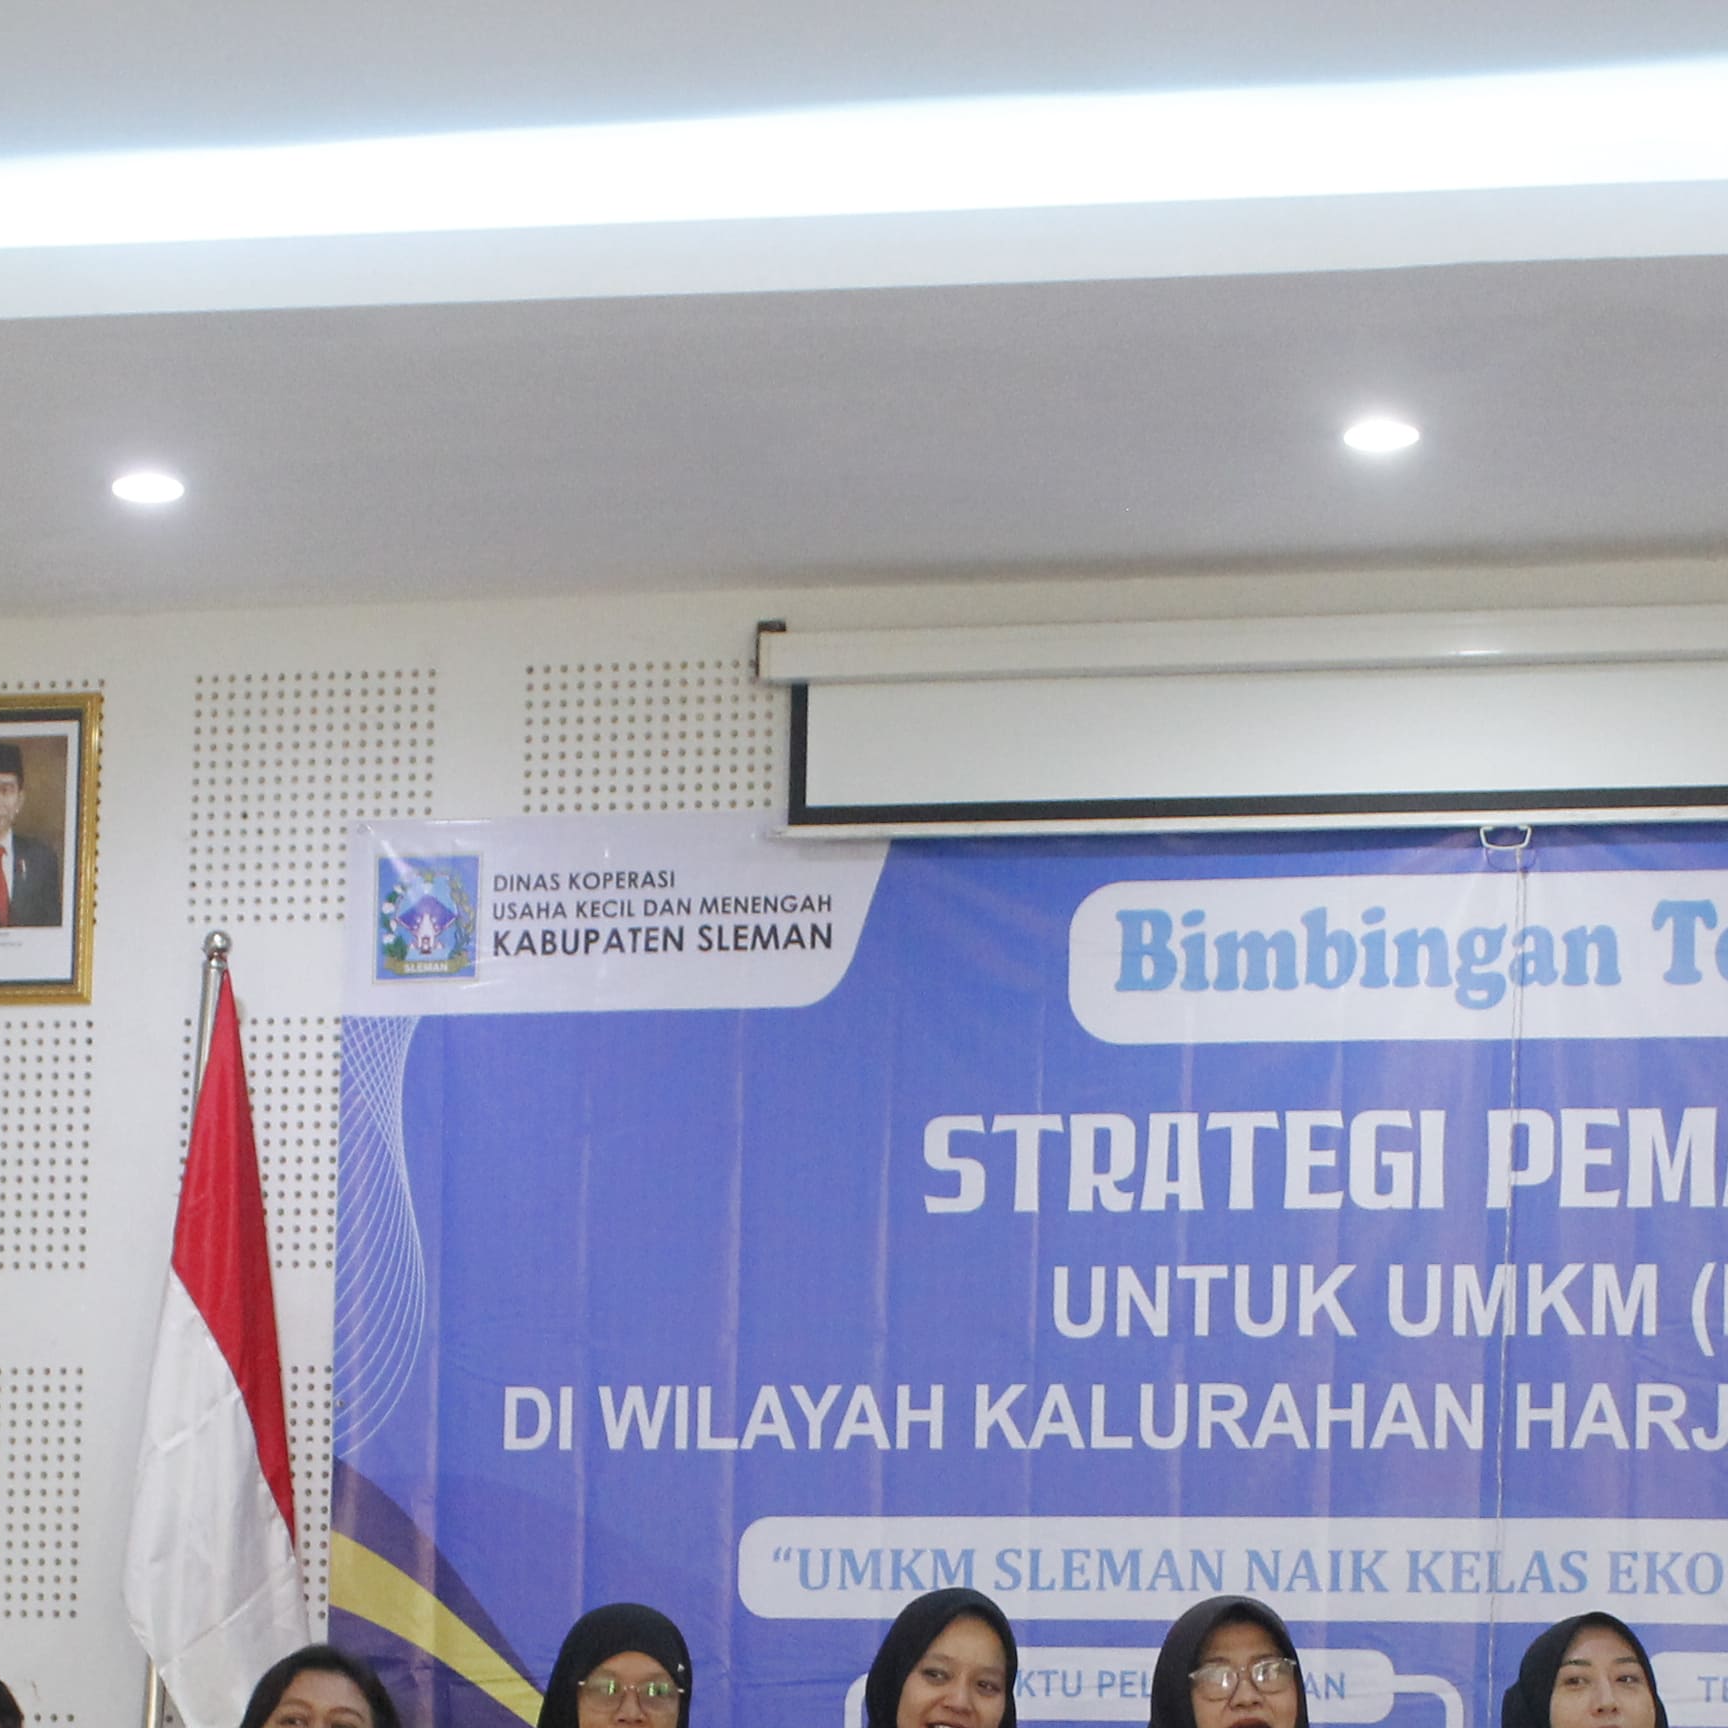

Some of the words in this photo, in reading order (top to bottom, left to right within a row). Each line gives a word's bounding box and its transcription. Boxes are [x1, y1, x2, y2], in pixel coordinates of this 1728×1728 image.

[493, 873, 561, 893] DINAS
[568, 870, 676, 891] KOPERASI
[492, 902, 567, 921] USAHA
[576, 900, 634, 918] KECIL
[643, 898, 691, 917] DAN
[699, 895, 831, 915] MENENGAH
[493, 925, 685, 957] KABUPATEN
[697, 923, 833, 953] SLEMAN
[1114, 905, 1622, 1010] Bimbingan
[403, 962, 448, 973] SLEMAN
[922, 1111, 1446, 1213] STRATEGI
[1051, 1263, 1358, 1338] UNTUK
[1385, 1262, 1659, 1338] UMKM
[502, 1386, 573, 1451] DI
[598, 1384, 944, 1451] WILAYAH
[975, 1383, 1485, 1450] KALURAHAN
[994, 1547, 1224, 1592] SLEMAN
[1245, 1548, 1389, 1594] NAIK
[1406, 1549, 1588, 1595] KELAS
[1016, 1669, 1083, 1697] KTU
